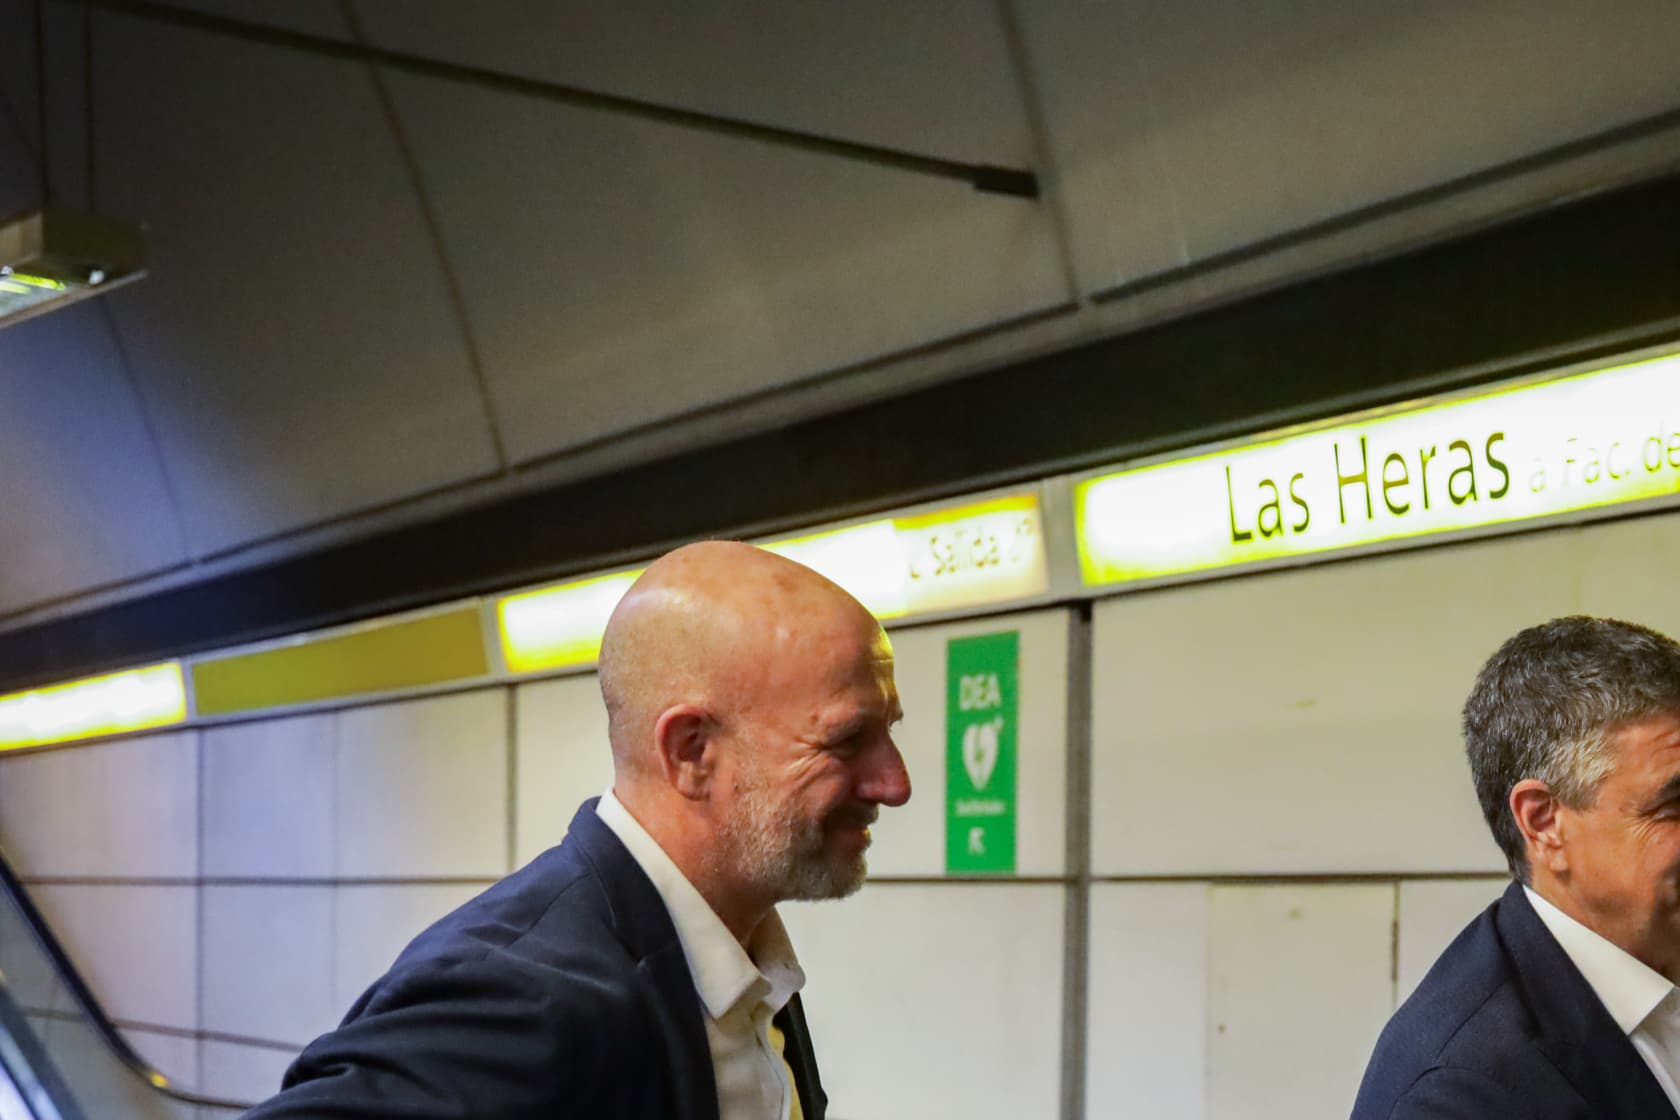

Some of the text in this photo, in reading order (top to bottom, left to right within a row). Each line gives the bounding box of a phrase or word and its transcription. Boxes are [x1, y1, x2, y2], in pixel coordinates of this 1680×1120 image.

[1225, 464, 1311, 545] Las
[1333, 431, 1511, 526] Heras
[959, 673, 1002, 711] DEA
